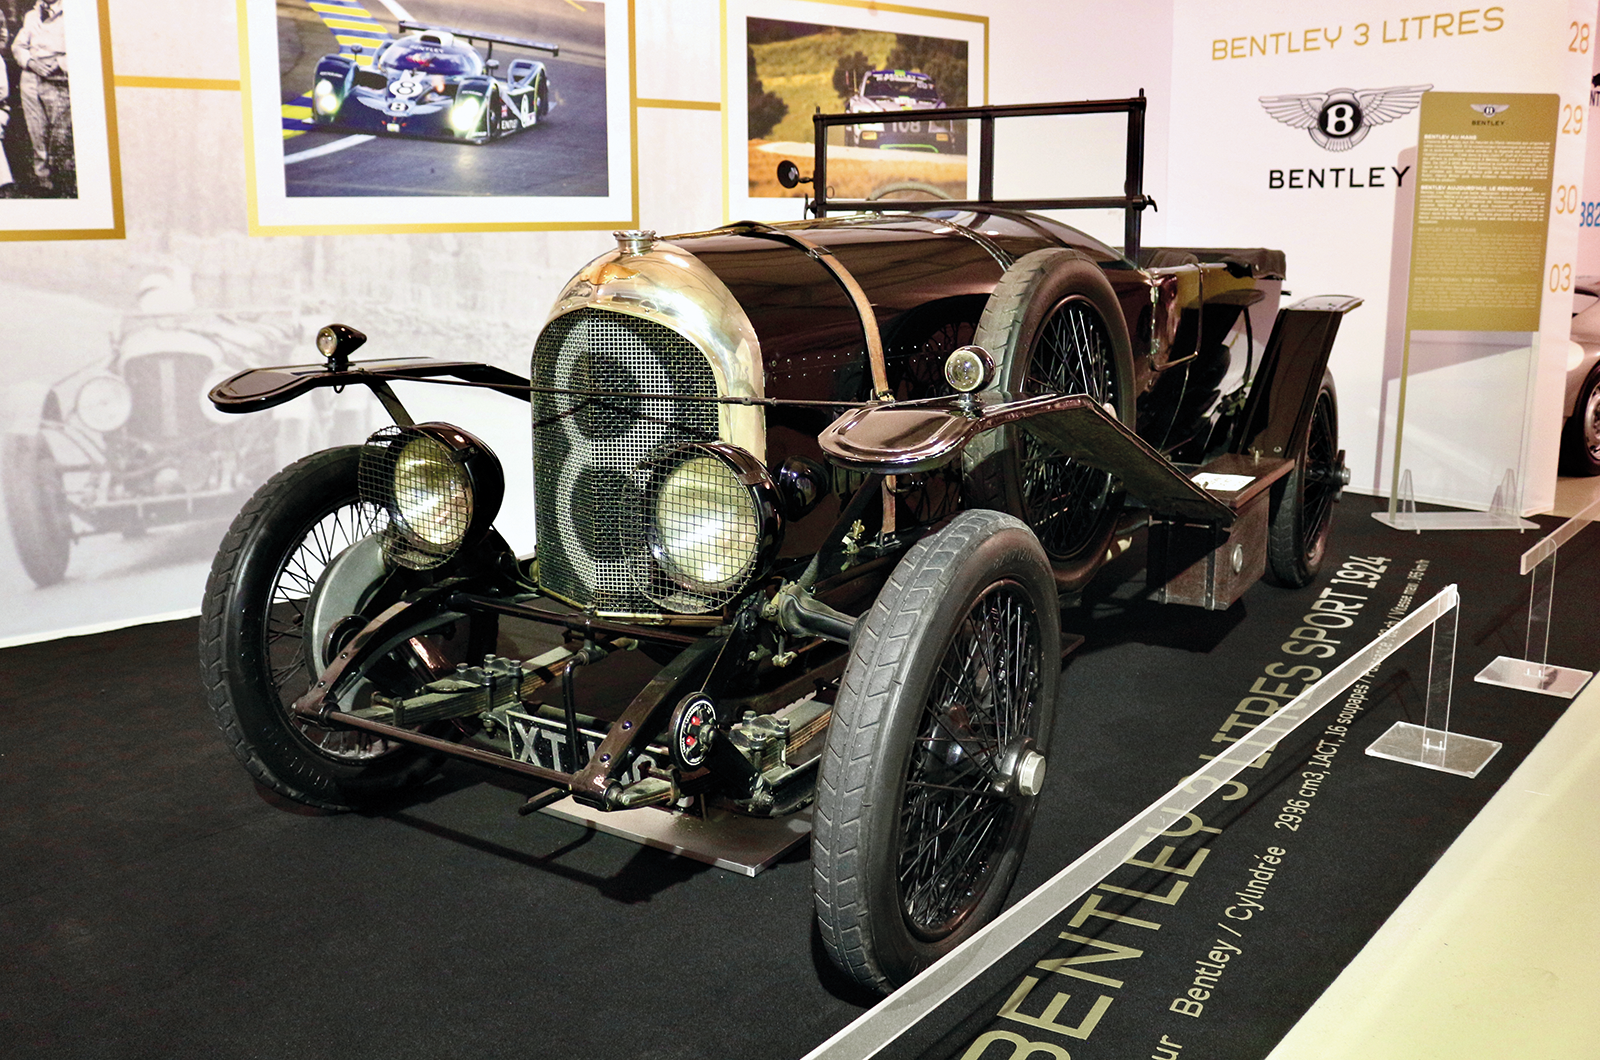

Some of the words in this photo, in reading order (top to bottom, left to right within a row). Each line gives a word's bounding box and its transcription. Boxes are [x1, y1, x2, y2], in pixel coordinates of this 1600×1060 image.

[1212, 25, 1342, 61] BENTLEY
[1353, 23, 1370, 46] 3
[1382, 6, 1505, 44] LITRES
[1568, 21, 1590, 54] 28
[1562, 104, 1584, 135] 29
[1269, 166, 1411, 189] BENTLEY
[1555, 185, 1578, 214] 30
[1549, 263, 1571, 293] 03
[1330, 555, 1392, 589] 1924
[1280, 586, 1369, 659] SPORT
[1199, 661, 1323, 770] LITRES
[1177, 774, 1249, 801] 3
[1169, 938, 1243, 1018] Bentley
[1224, 846, 1286, 921] Cylindrée
[1274, 798, 1311, 832] 2996
[1324, 725, 1348, 738] 16
[1336, 684, 1370, 725] soupapes
